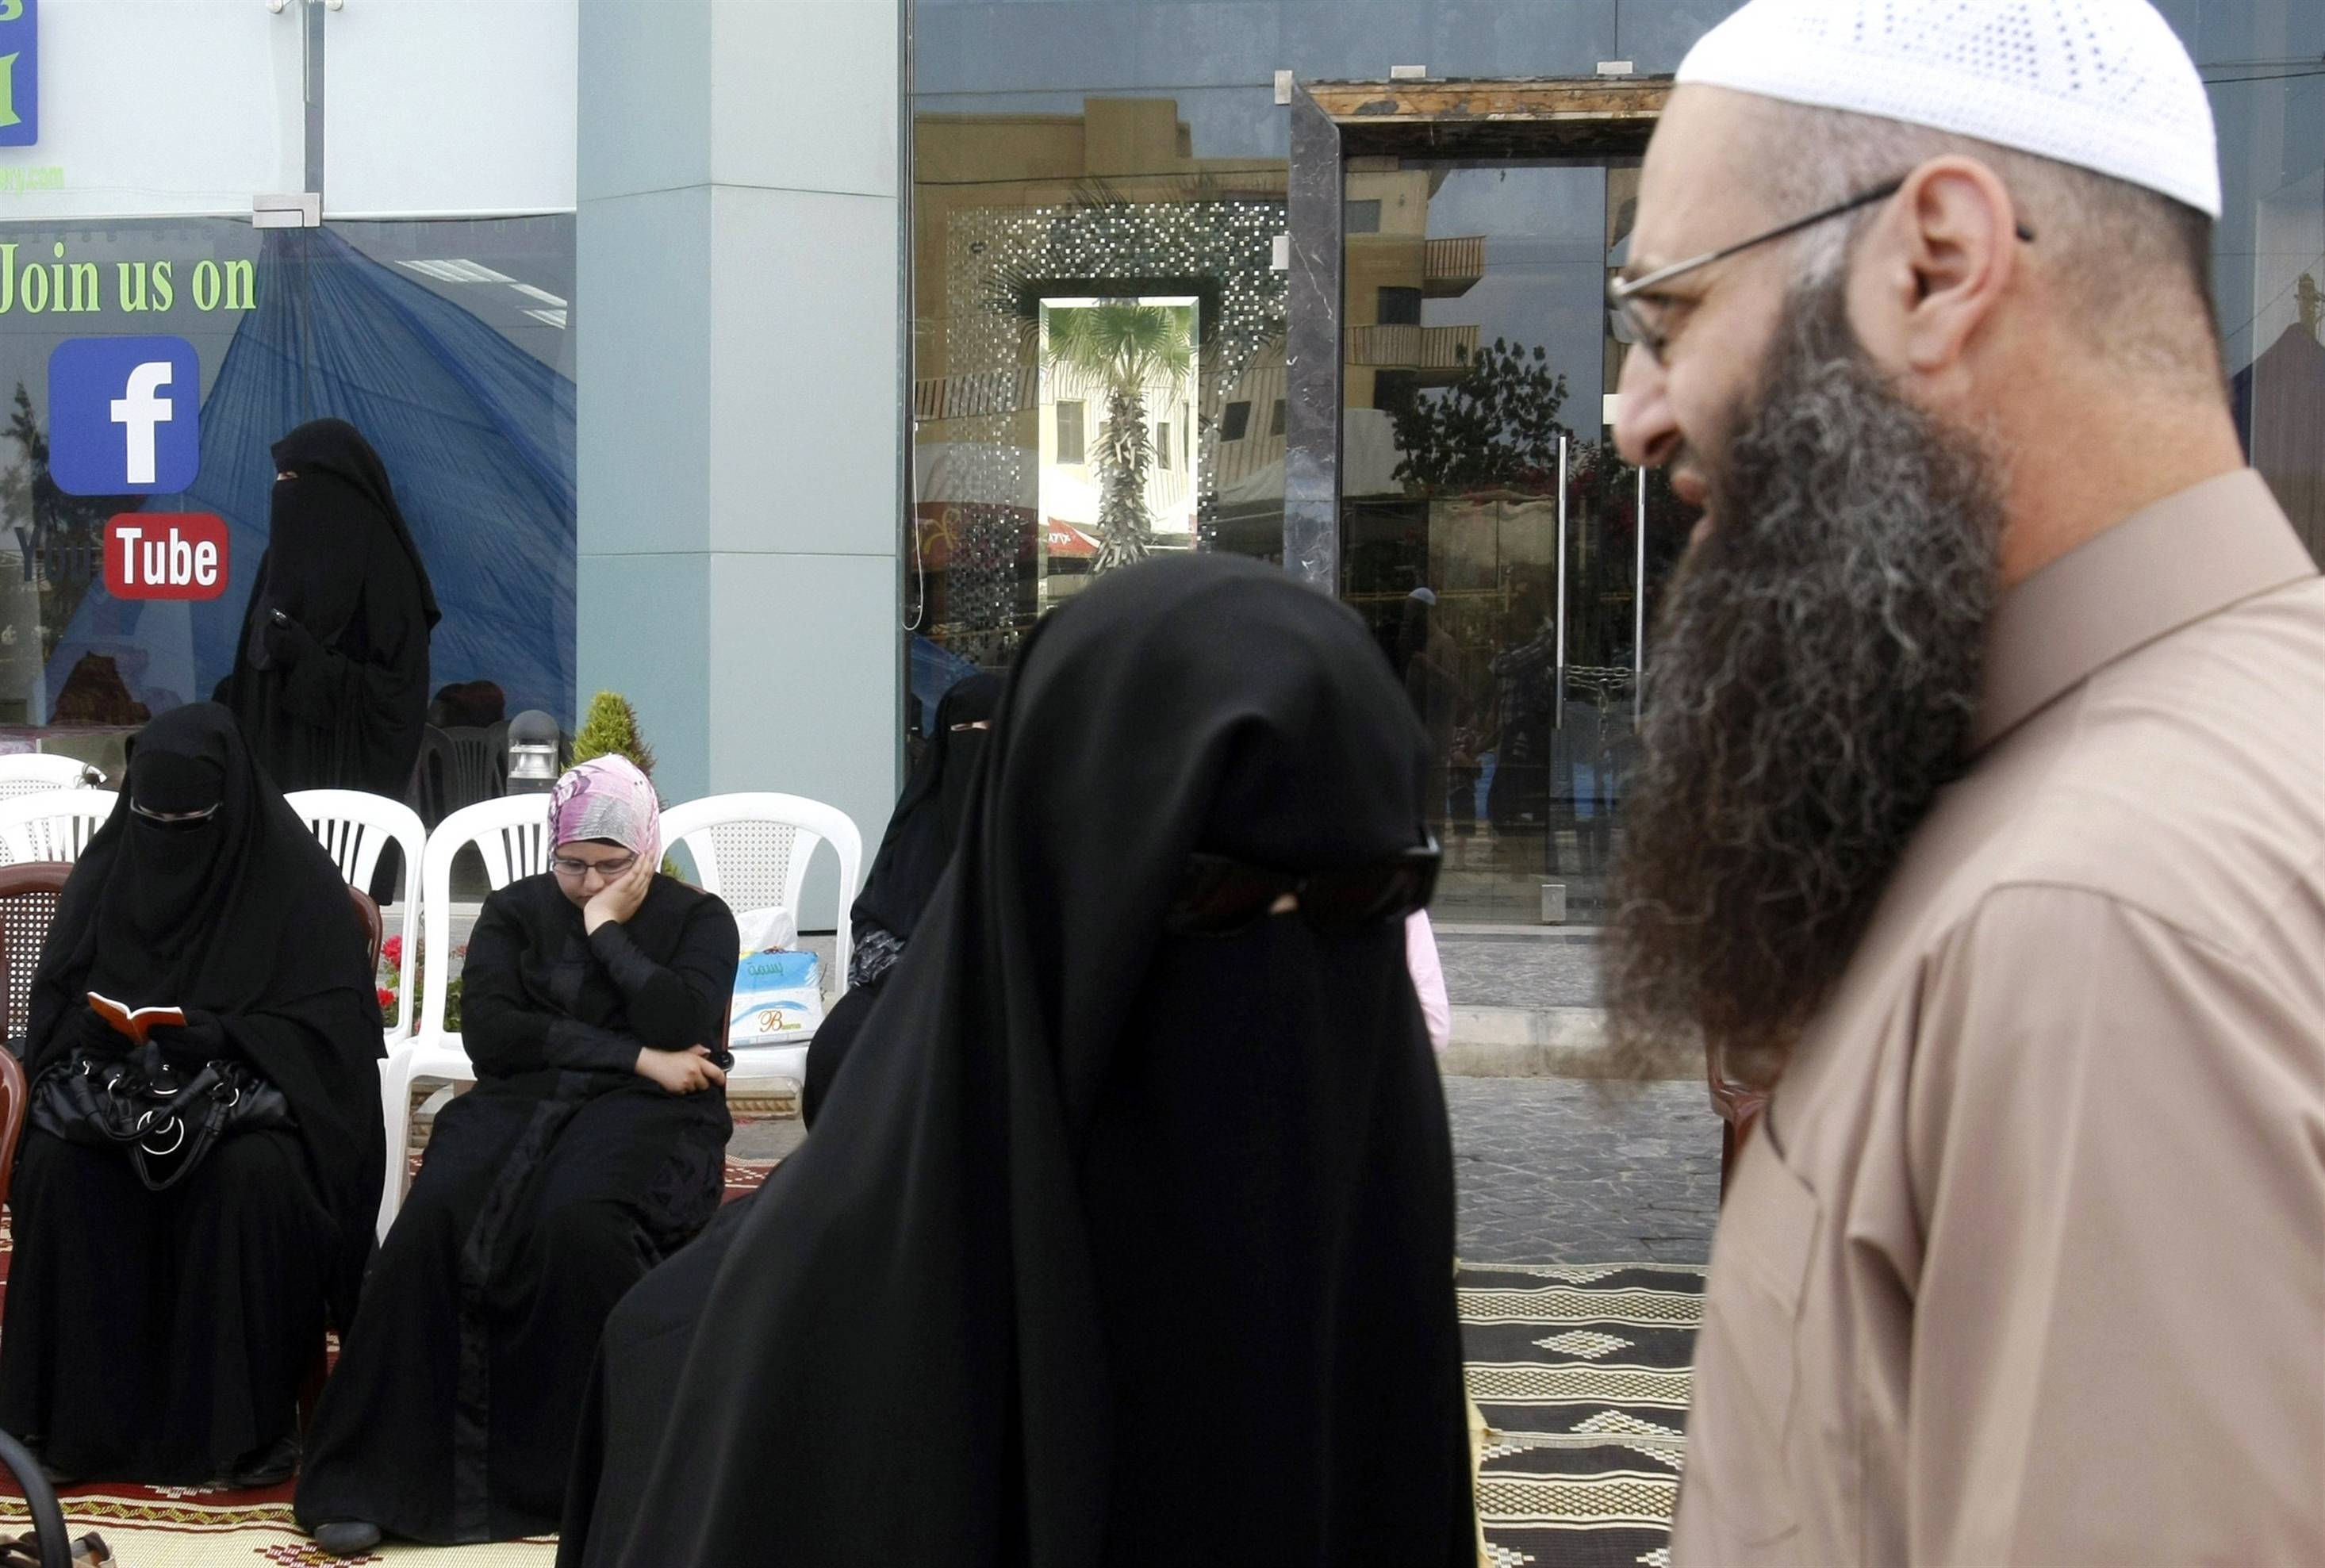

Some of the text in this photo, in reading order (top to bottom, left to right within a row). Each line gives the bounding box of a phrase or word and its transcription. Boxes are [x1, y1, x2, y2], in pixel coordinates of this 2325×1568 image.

[0, 242, 256, 313] Join us on
